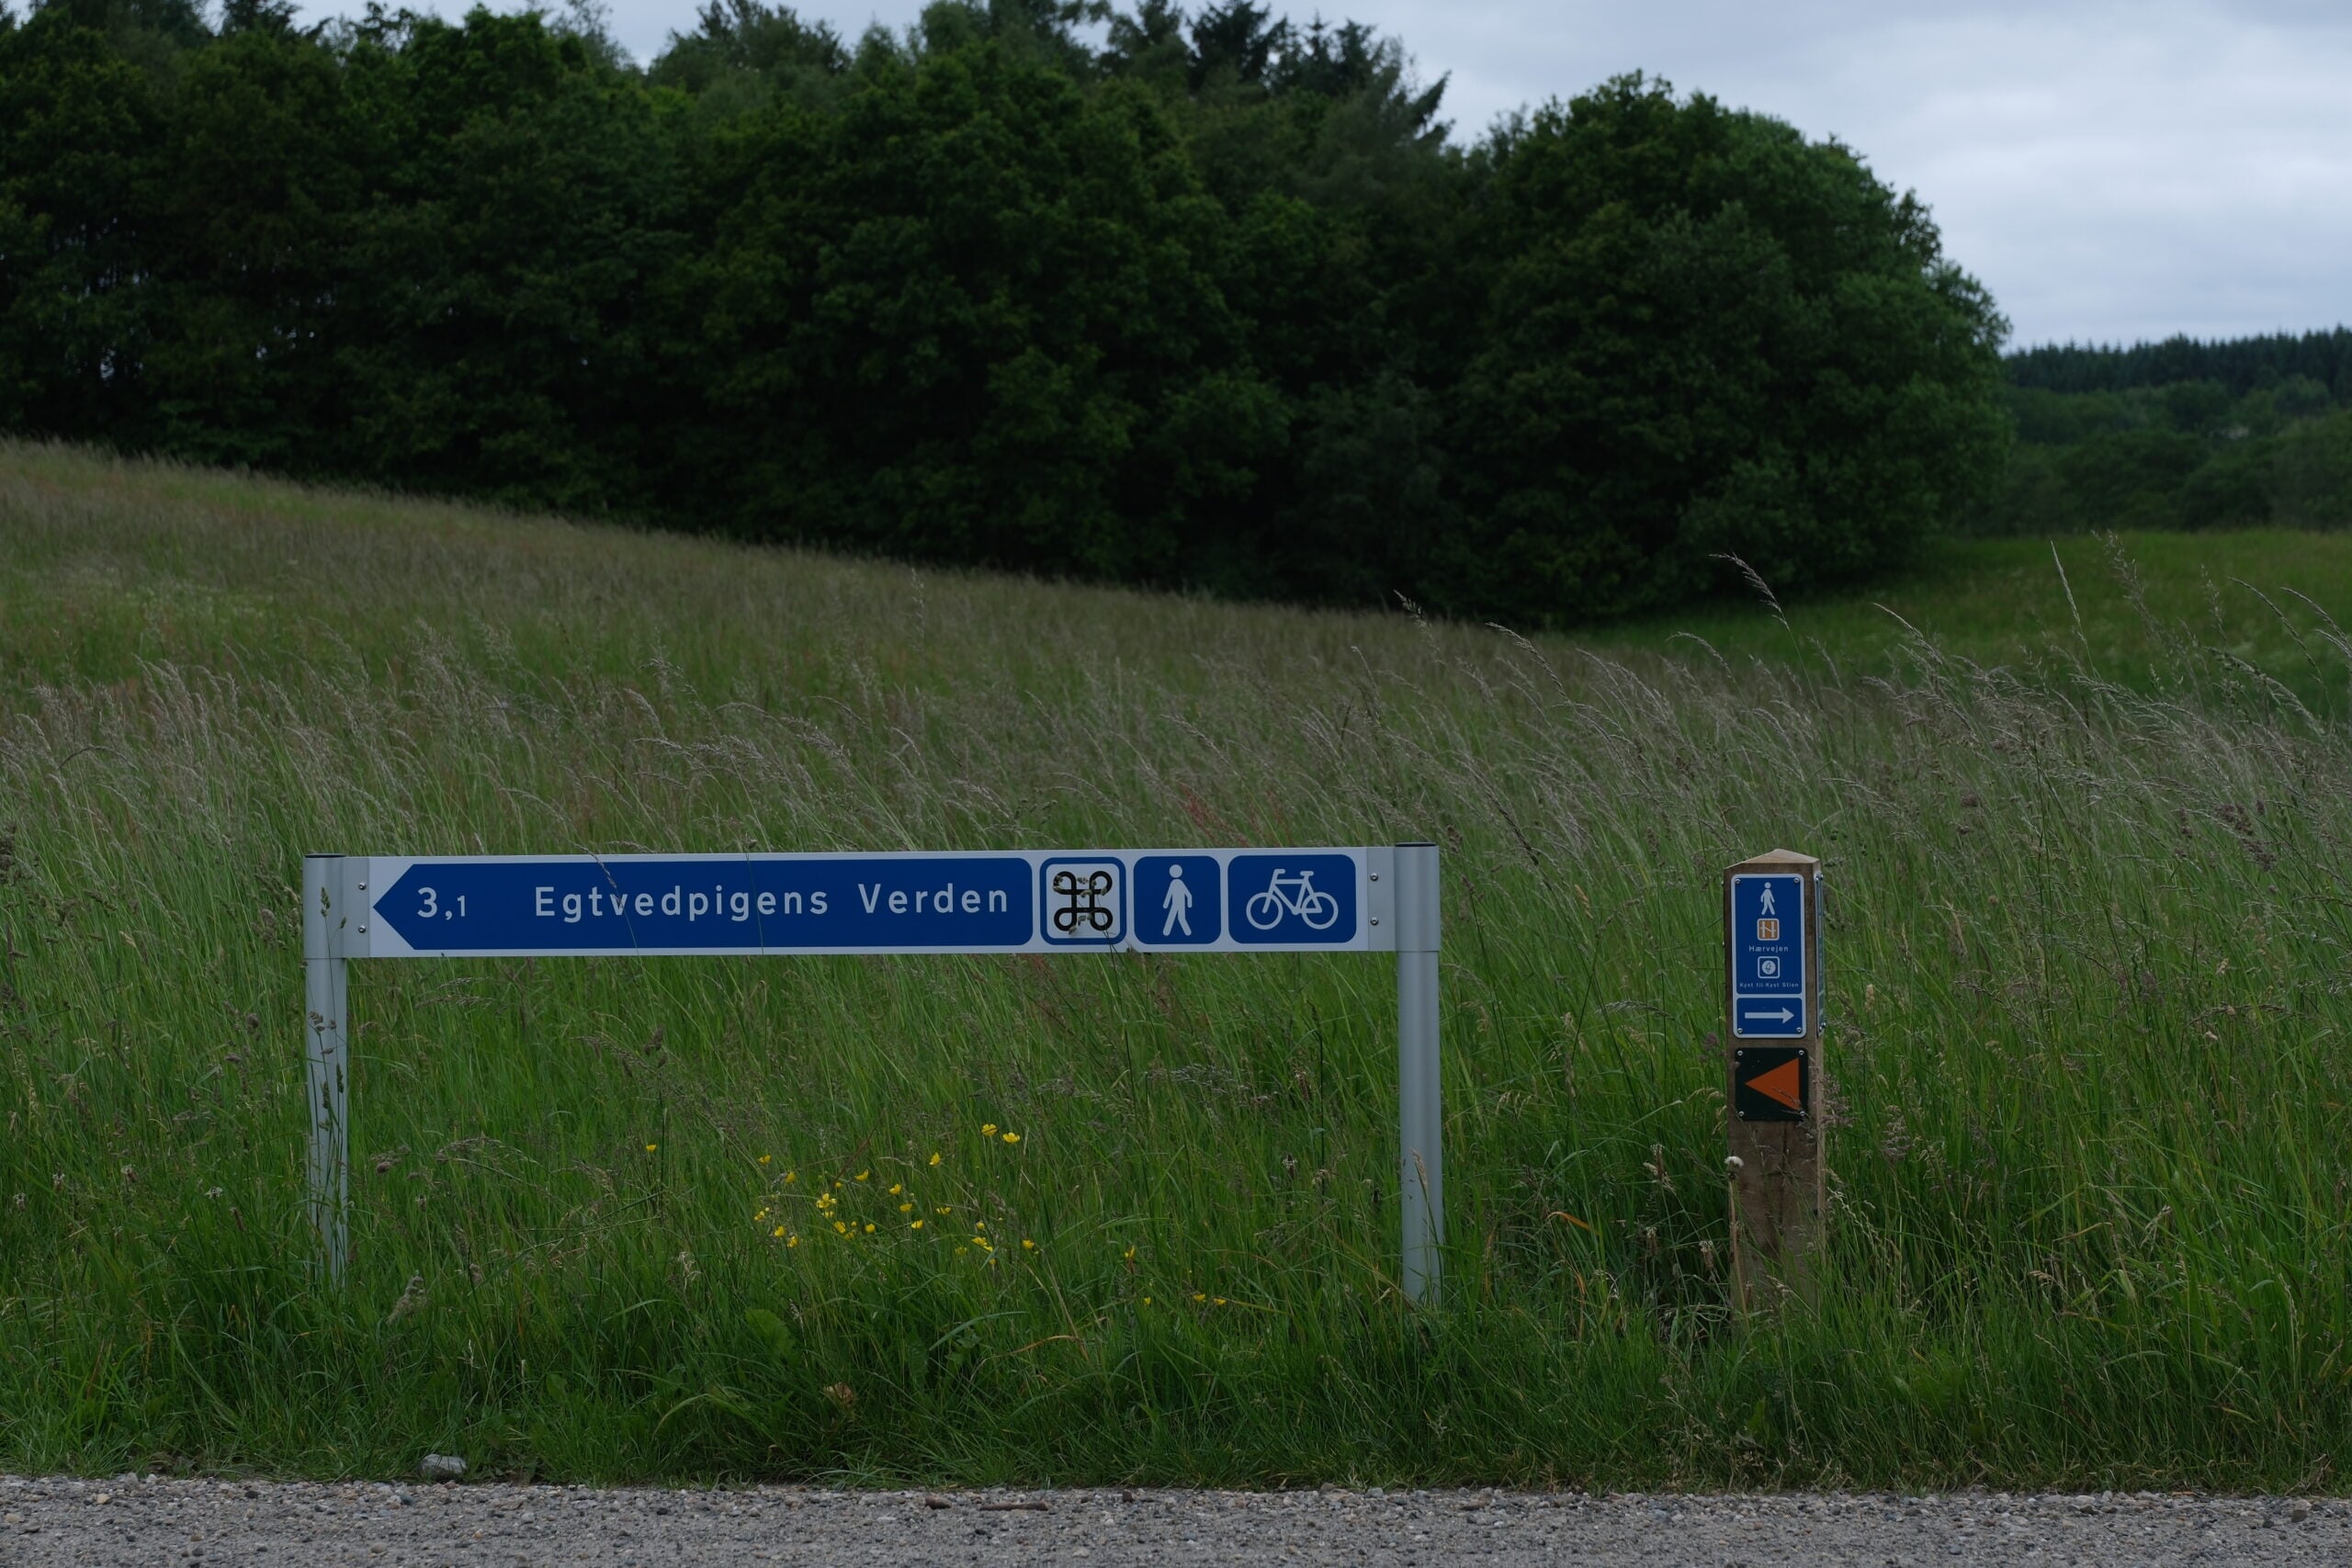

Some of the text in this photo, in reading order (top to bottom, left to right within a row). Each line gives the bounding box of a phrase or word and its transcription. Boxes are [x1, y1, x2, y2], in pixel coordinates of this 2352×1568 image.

[417, 883, 1007, 923] 3,1 Egtvedpigens Verden
[1748, 945, 1789, 953] Hærvejen
